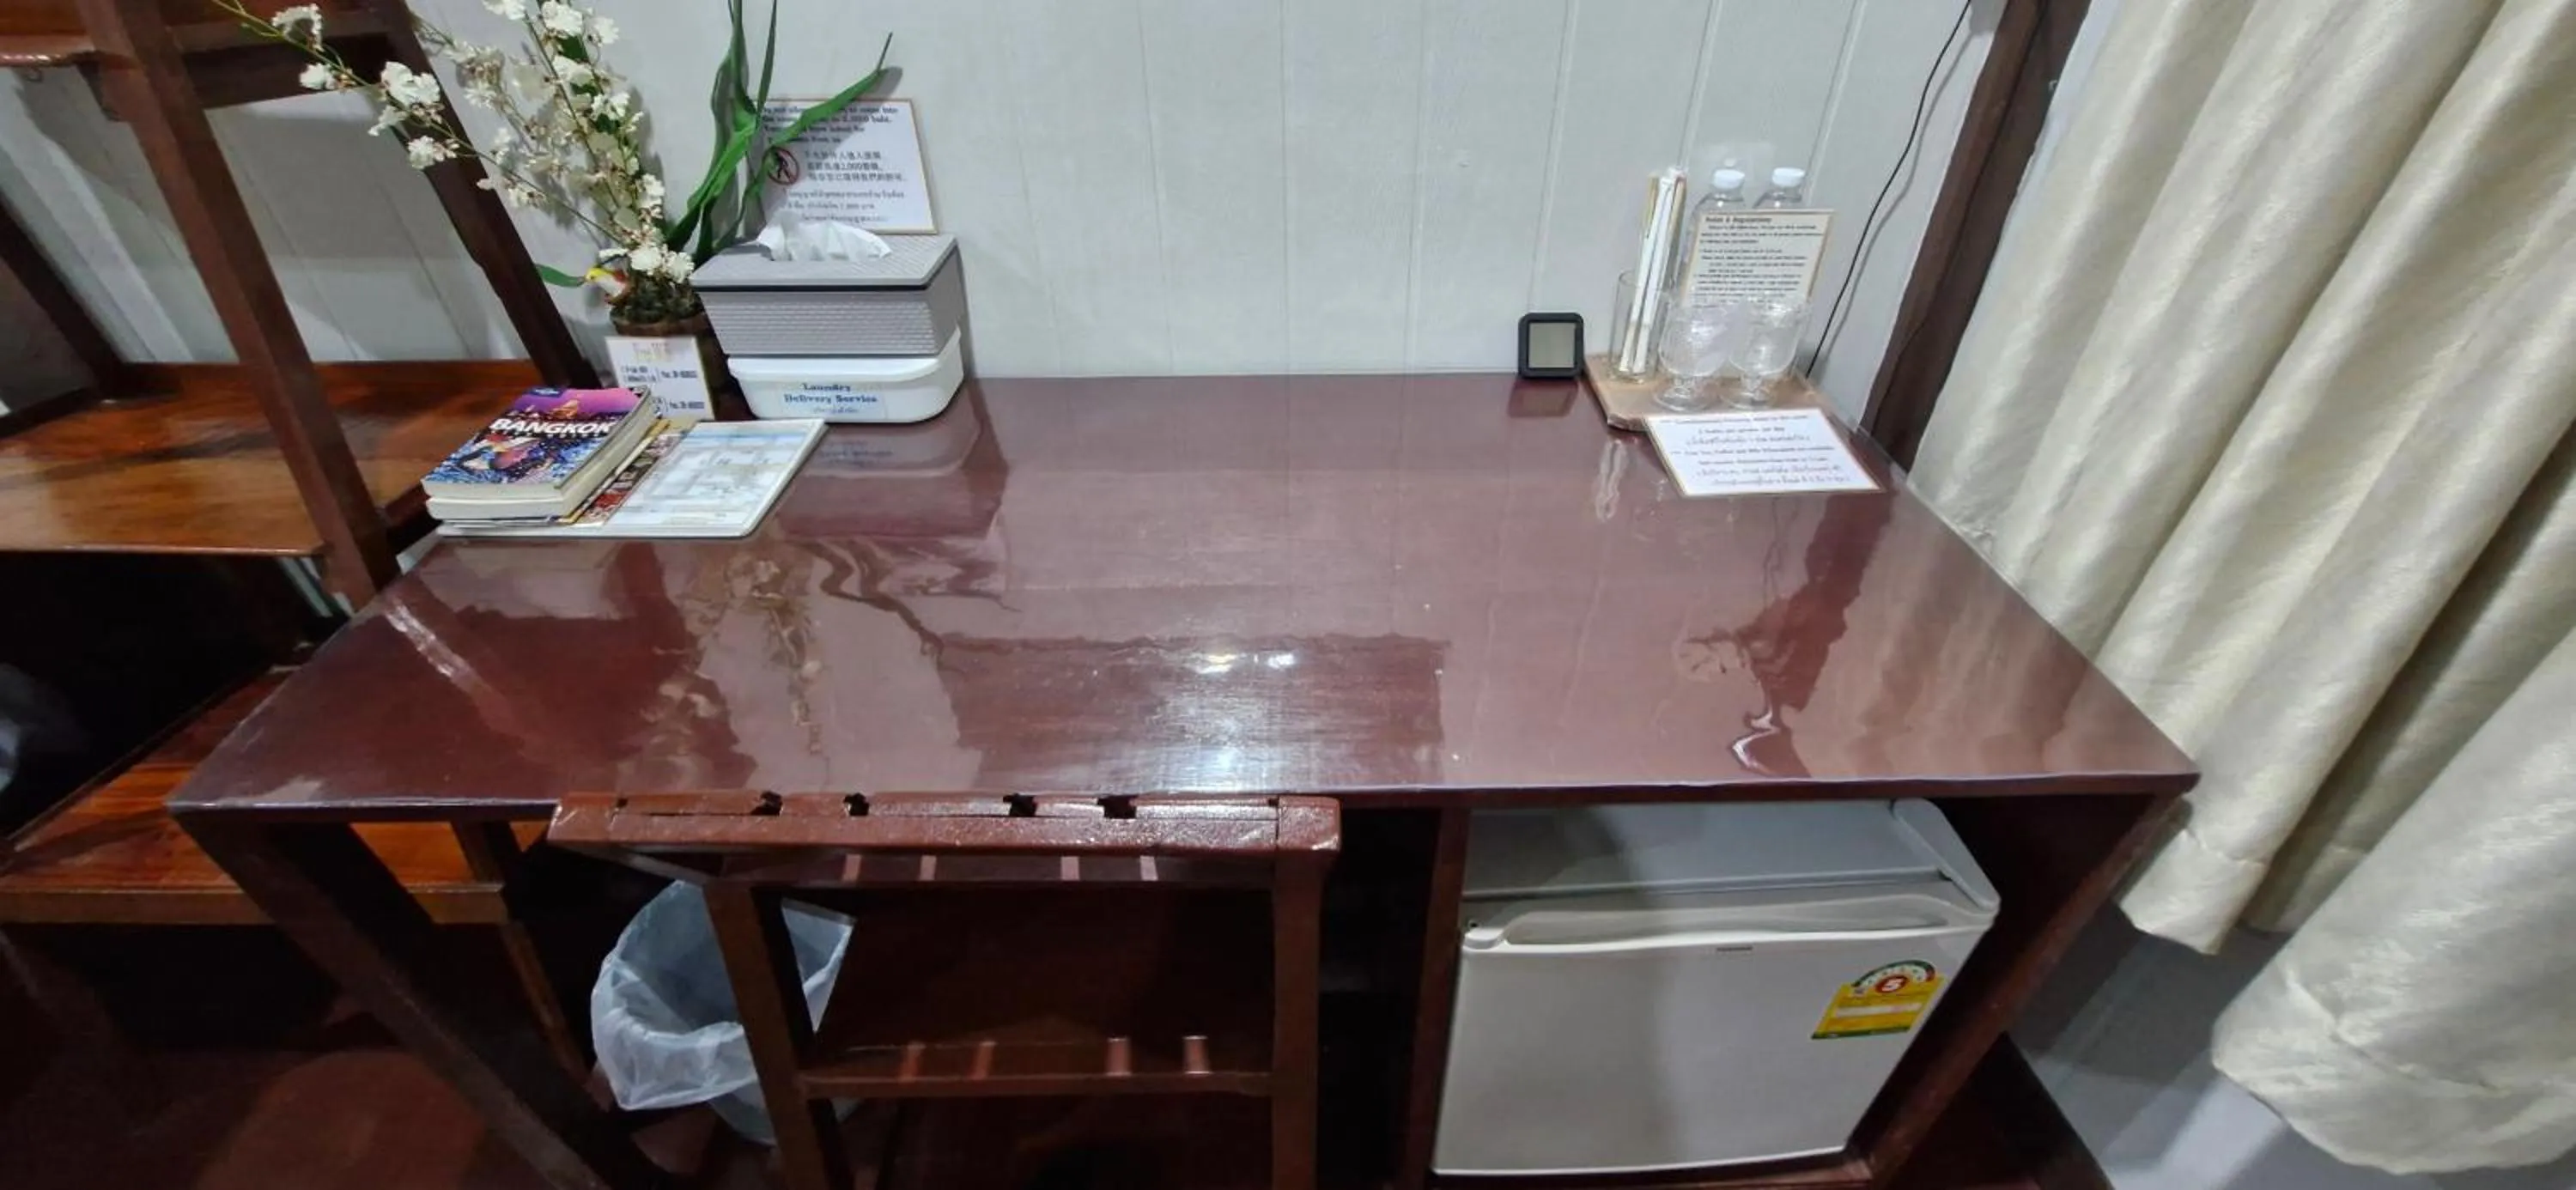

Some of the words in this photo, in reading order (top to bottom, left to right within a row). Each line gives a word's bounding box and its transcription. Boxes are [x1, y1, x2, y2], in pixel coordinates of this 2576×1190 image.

[802, 383, 851, 392] Laundry
[784, 394, 832, 404] Delivery
[835, 394, 878, 404] Service
[489, 418, 619, 434] BANGKOK
